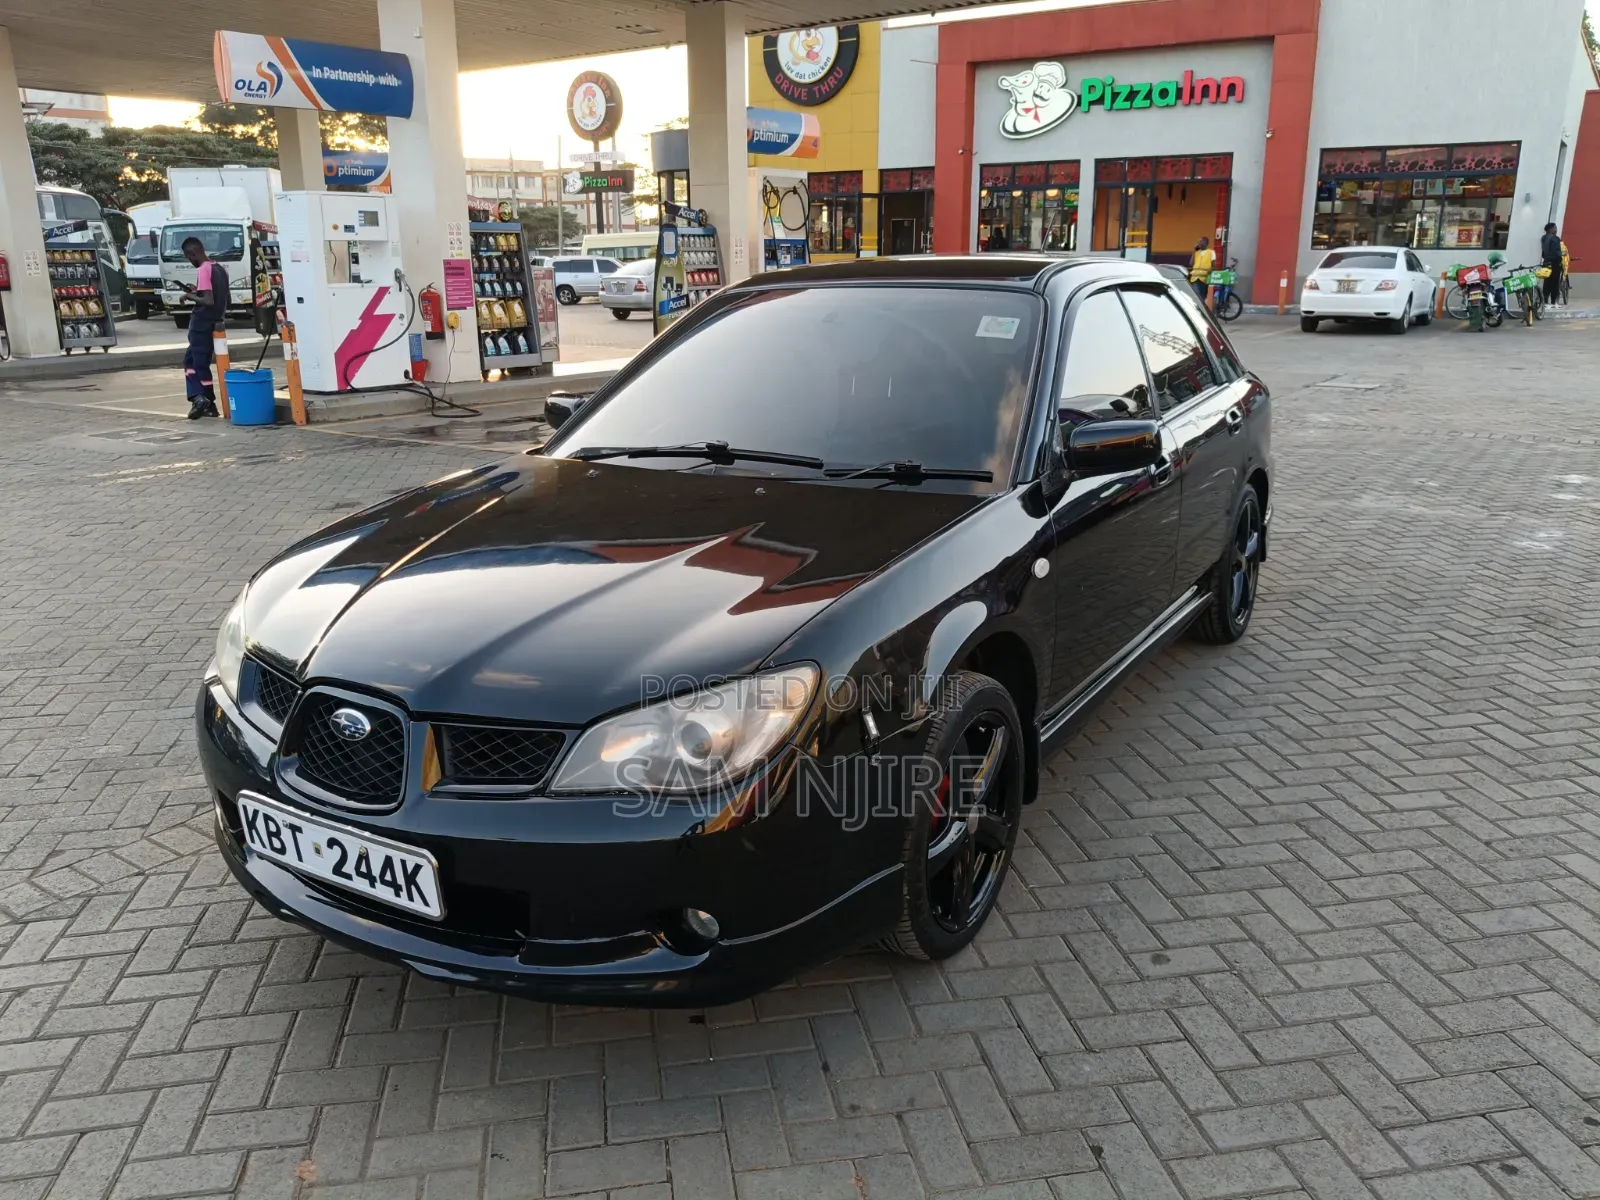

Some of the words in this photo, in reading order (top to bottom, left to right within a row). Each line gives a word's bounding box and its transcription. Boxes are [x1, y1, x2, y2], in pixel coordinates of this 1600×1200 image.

[784, 61, 795, 73] luv
[795, 71, 806, 80] dat
[807, 56, 832, 80] chicken
[312, 65, 321, 78] In
[323, 66, 375, 87] Partnership
[378, 72, 399, 87] with
[774, 72, 809, 100] DRIVE
[812, 66, 844, 99] THRU
[234, 78, 268, 93] OLA
[243, 91, 267, 99] ENERGY
[811, 138, 819, 149] 4
[678, 206, 697, 220] Accel
[52, 223, 74, 237] Accel
[668, 297, 687, 310] Accel
[241, 803, 304, 863] KBT
[326, 836, 432, 908] 244K
